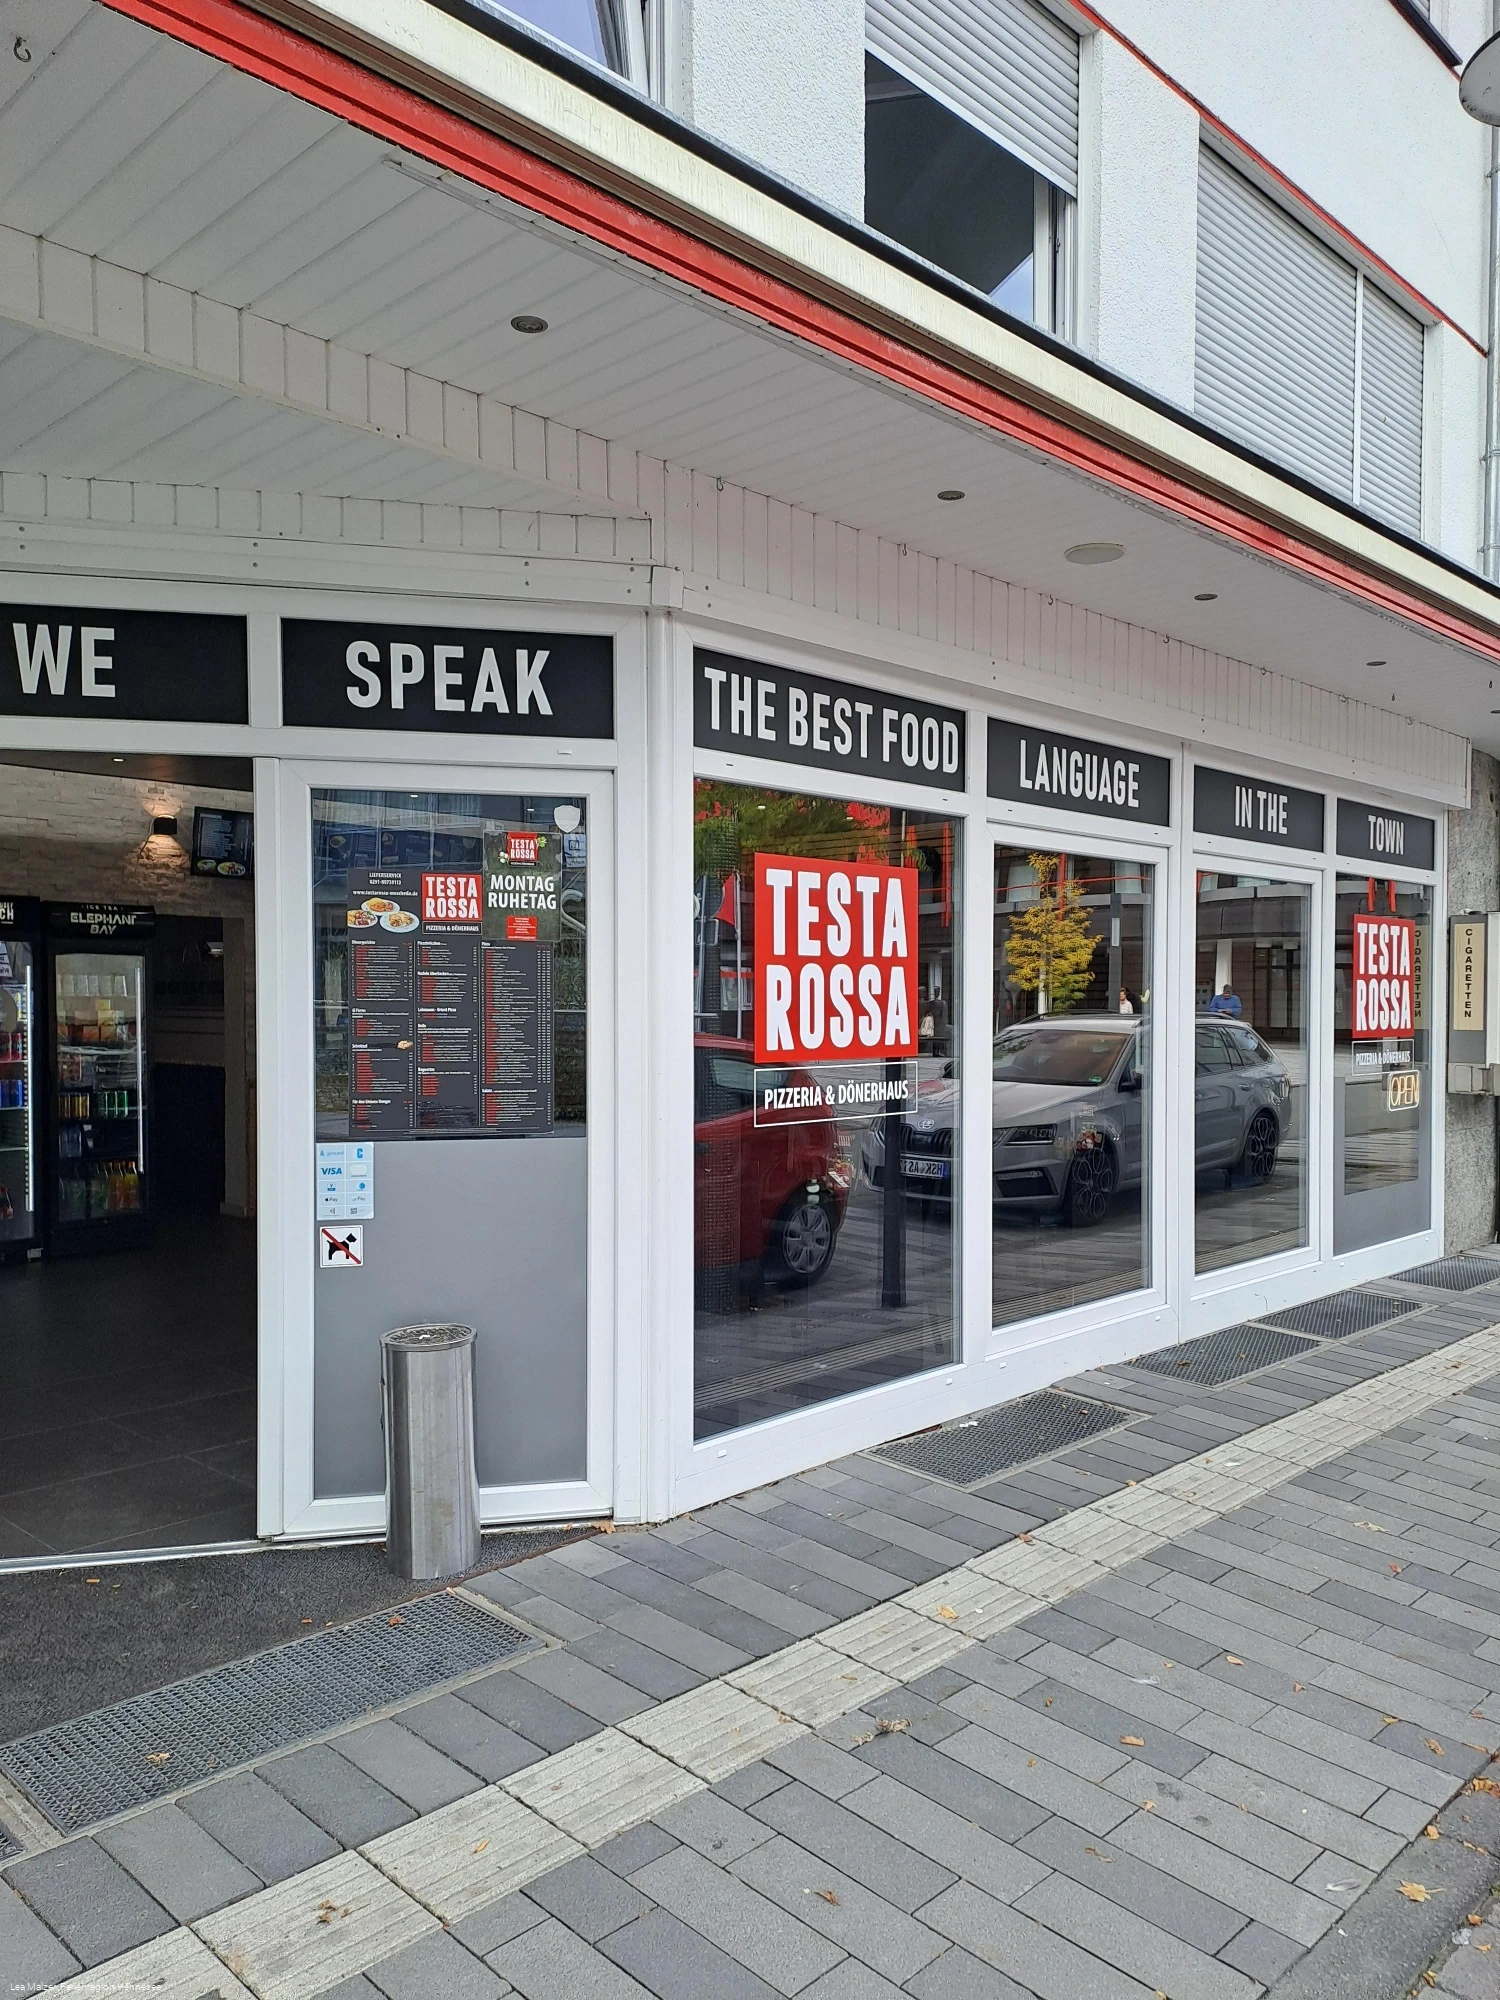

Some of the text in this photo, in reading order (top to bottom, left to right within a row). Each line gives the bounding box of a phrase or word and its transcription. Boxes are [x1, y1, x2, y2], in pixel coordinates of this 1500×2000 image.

[12, 623, 116, 698] WE
[345, 640, 554, 716] SPEAK
[703, 666, 960, 774] THE BEST FOOD
[1018, 738, 1140, 809] LANGUAGE
[1234, 784, 1289, 836] IN THE
[510, 838, 535, 851] TESTA
[1367, 813, 1404, 857] TOWN
[510, 849, 535, 860] ROSSA
[425, 876, 478, 898] TESTA
[490, 874, 555, 893] MONTAG
[425, 898, 479, 919] ROSSA
[487, 892, 557, 910] RUHETAG
[765, 868, 908, 958] TESTA
[70, 912, 137, 925] ELEPHANT
[90, 925, 117, 935] BAY
[1357, 922, 1411, 976] TESTA
[1464, 928, 1473, 1018] CIGARETTEN
[765, 962, 911, 1051] ROSSA
[1356, 978, 1412, 1032] ROSSA
[1355, 1052, 1378, 1066] PIZZERIA
[1382, 1049, 1411, 1064] DÖNERHAUS
[764, 1079, 909, 1110] PIZZERIA & DÖNERHAUS
[1390, 1074, 1419, 1107] OPEN
[320, 1167, 343, 1175] VISA
